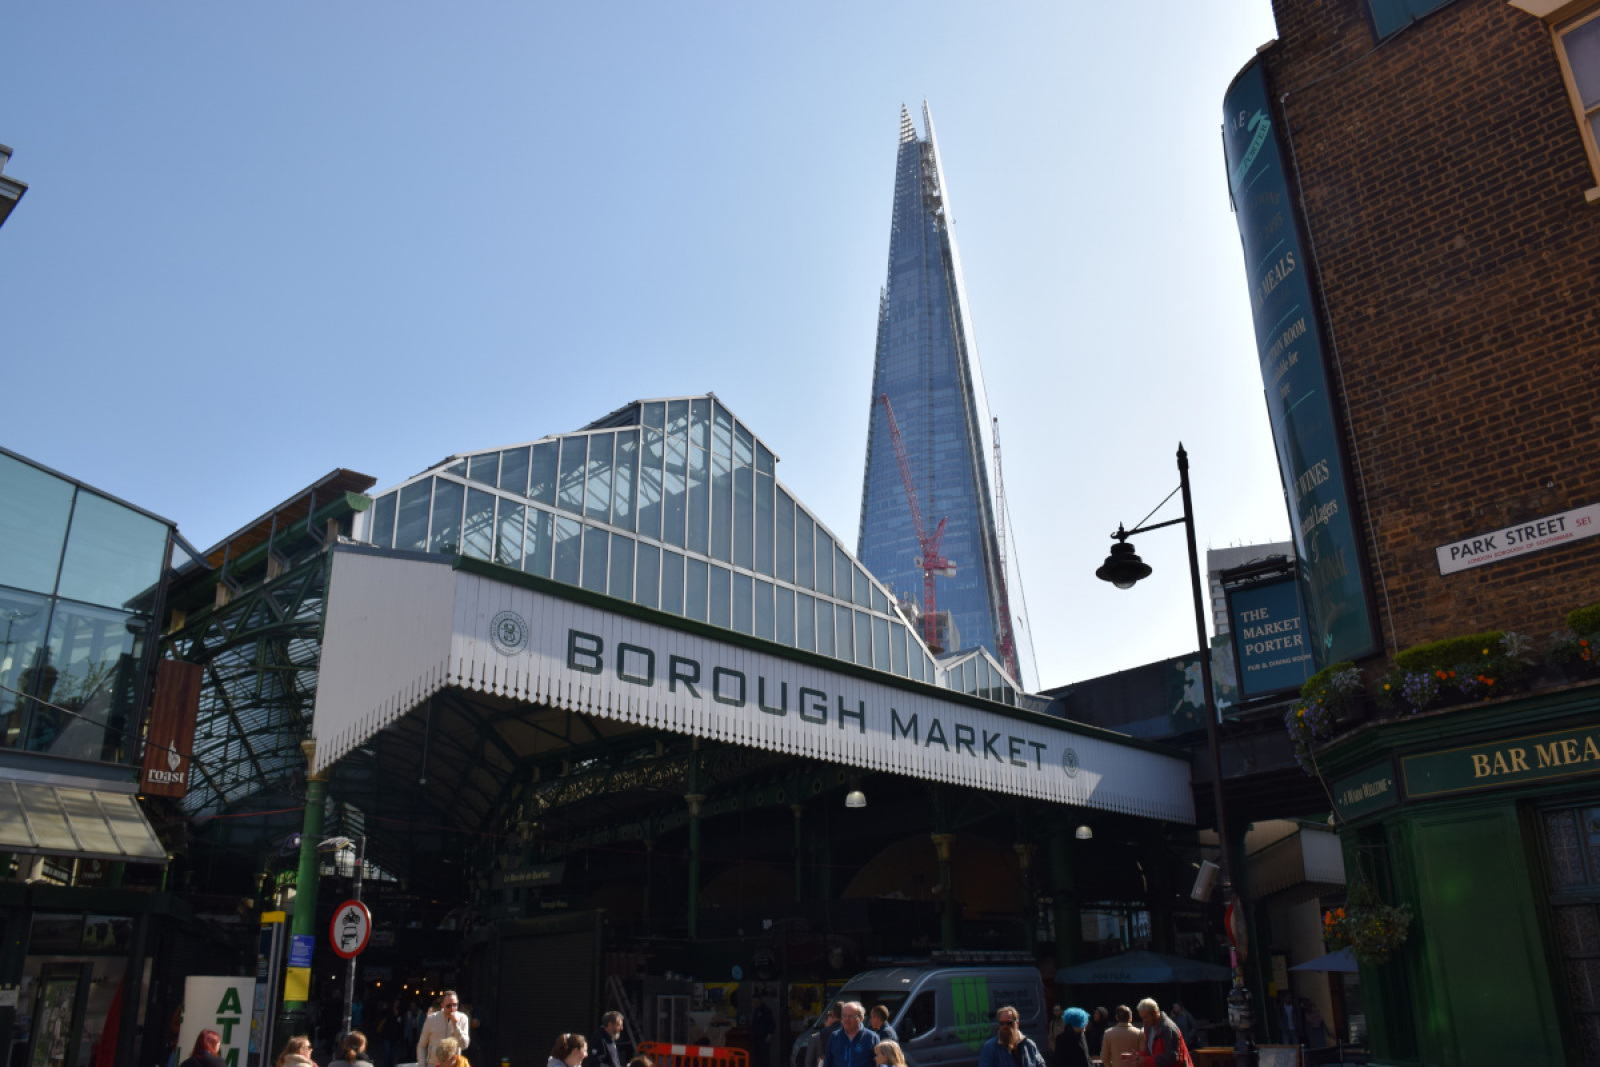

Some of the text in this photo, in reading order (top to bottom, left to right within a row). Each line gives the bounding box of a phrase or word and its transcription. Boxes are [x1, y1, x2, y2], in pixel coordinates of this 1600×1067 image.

[1262, 251, 1296, 299] MEALS
[1283, 317, 1306, 348] ROOM
[1299, 459, 1329, 496] WINES
[1451, 516, 1592, 560] PARK STREET SE1
[1467, 554, 1492, 565] LONDON
[1494, 546, 1525, 558] BOROUGH
[1536, 532, 1574, 546] SOUTHWARK
[1240, 607, 1270, 623] THE
[1243, 617, 1300, 640] MARKET
[1245, 634, 1304, 656] PORTER
[1247, 663, 1260, 672] PUB
[1269, 657, 1291, 668] DINING
[567, 627, 1047, 772] BOROUGH MARKET
[1471, 734, 1600, 778] BAR MEA
[148, 769, 184, 783] roast
